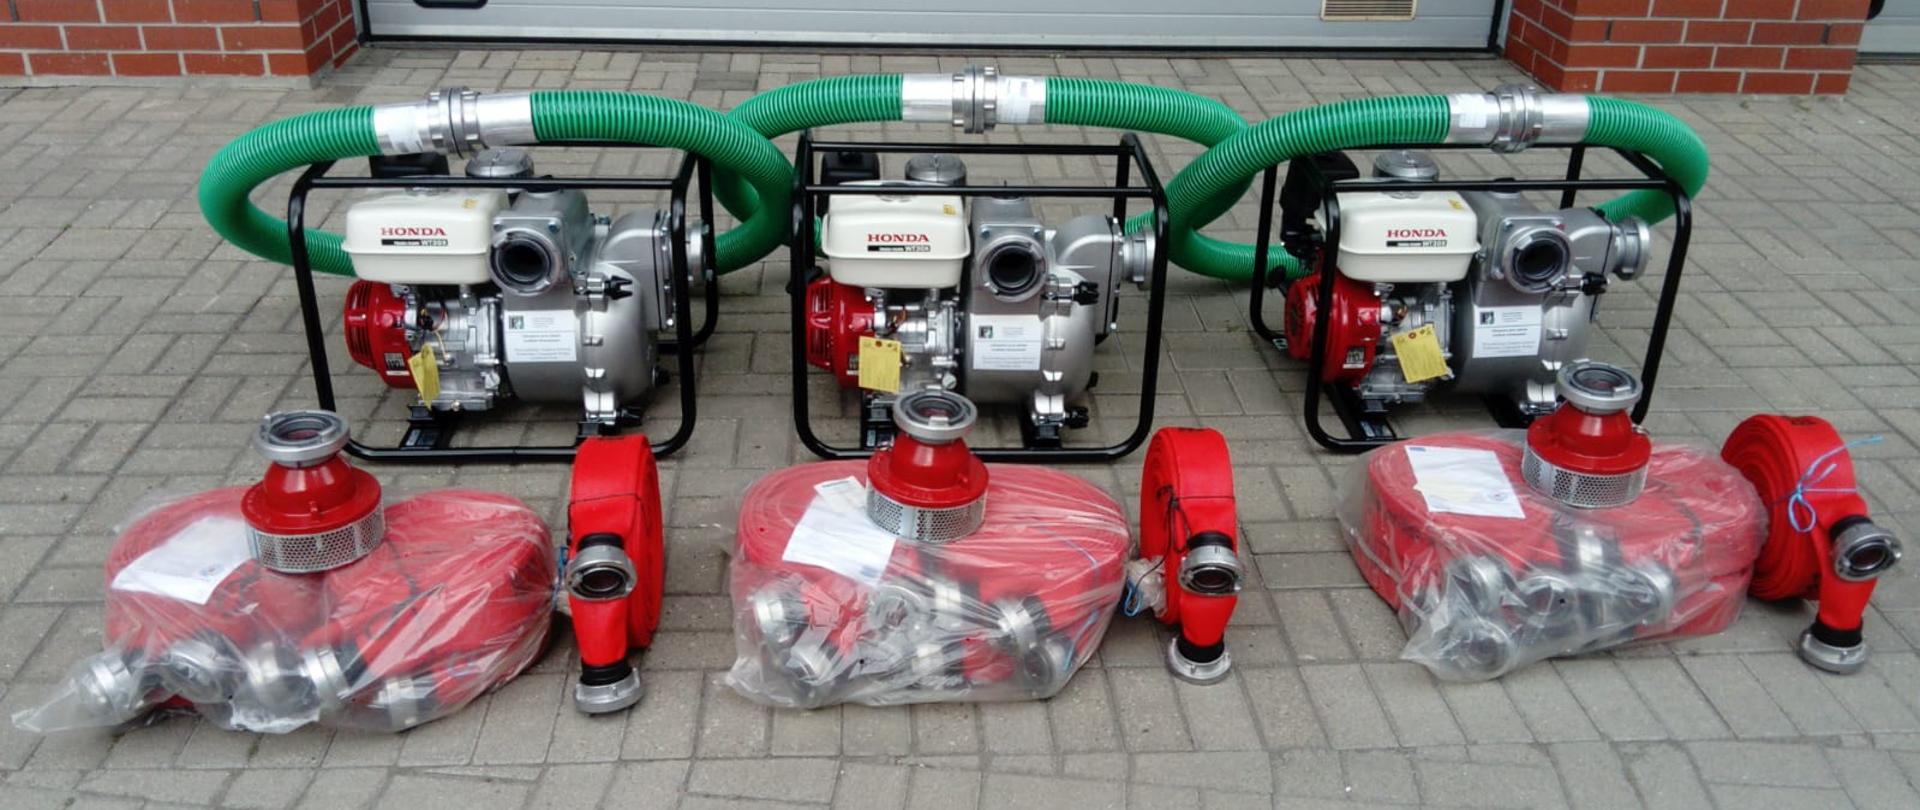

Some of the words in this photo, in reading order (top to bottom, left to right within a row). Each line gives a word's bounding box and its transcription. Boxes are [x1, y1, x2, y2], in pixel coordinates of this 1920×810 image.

[381, 227, 447, 237] HONDA
[1386, 228, 1447, 238] HONDA
[867, 233, 930, 243] HONDA
